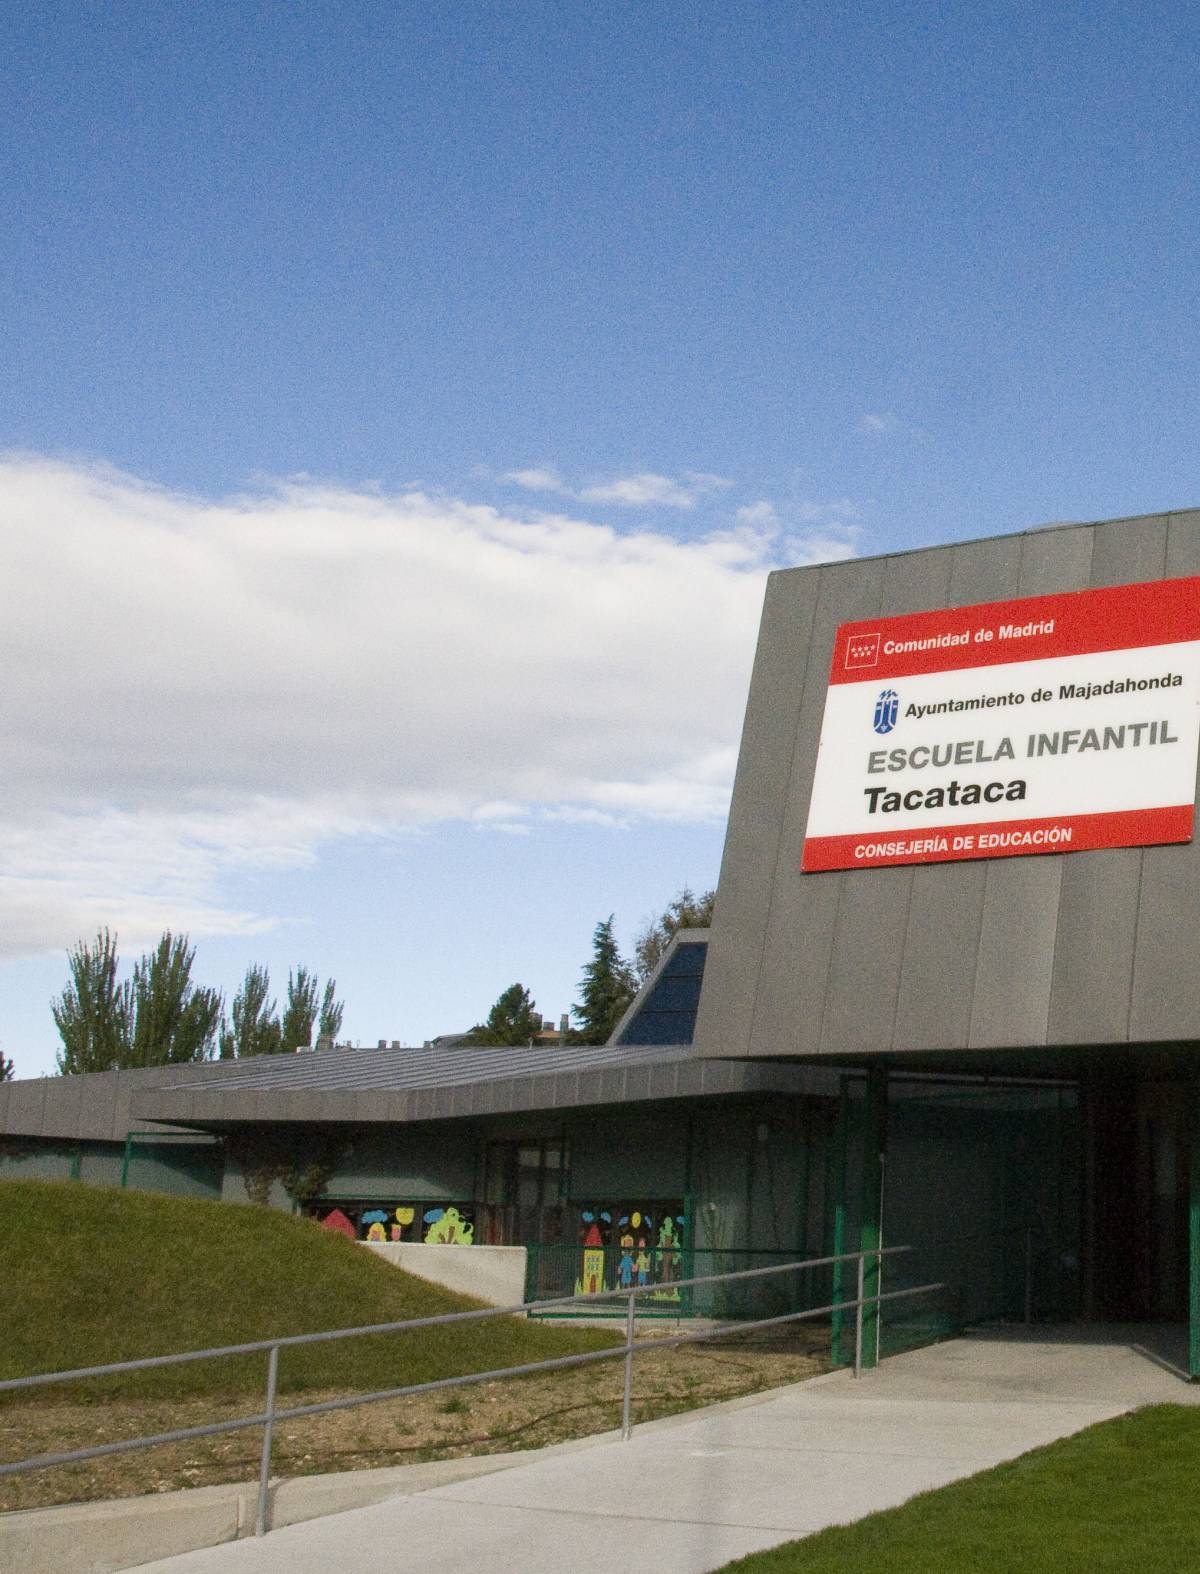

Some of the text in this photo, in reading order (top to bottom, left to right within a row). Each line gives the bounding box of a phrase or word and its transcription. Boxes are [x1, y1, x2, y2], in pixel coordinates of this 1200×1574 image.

[884, 619, 1055, 656] Comunidad de Madrid
[905, 673, 1183, 719] Ayuntamiento de Majadahonda
[867, 720, 1179, 775] ESCUELA INFANTIL
[864, 779, 1027, 814] Tacataca
[854, 826, 1072, 859] CONSEJERÍA DE EDUCACIÓN
